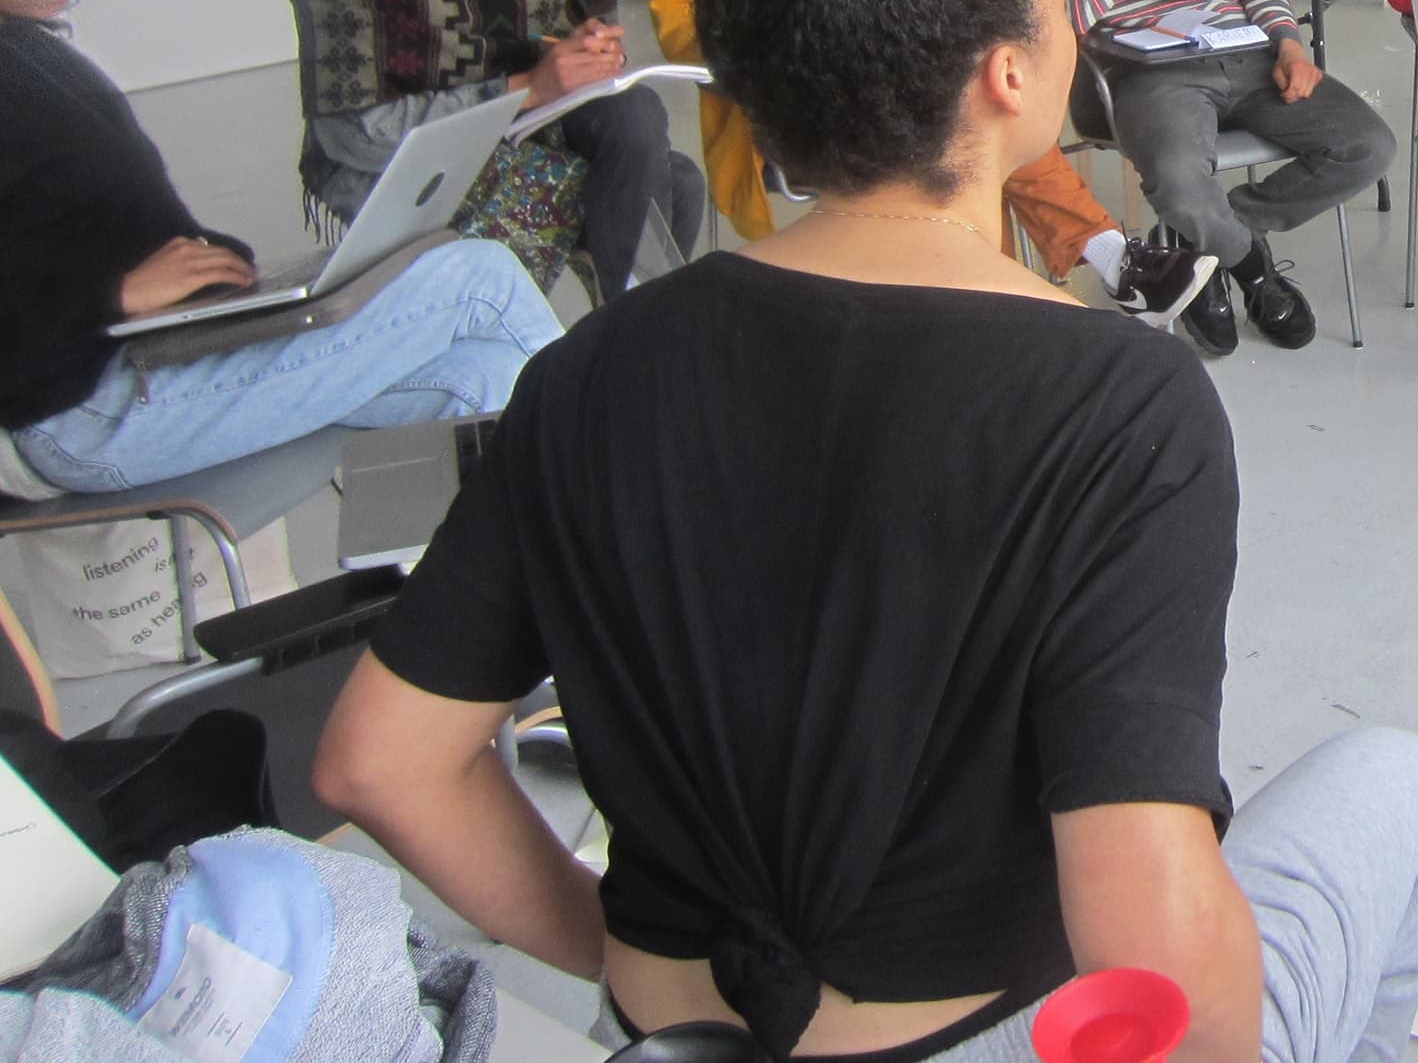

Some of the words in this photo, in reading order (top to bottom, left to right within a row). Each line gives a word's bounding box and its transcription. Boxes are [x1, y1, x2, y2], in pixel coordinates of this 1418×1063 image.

[82, 537, 160, 581] listening
[155, 556, 167, 573] is
[72, 605, 104, 621] the
[108, 590, 161, 619] same
[131, 627, 153, 645] as
